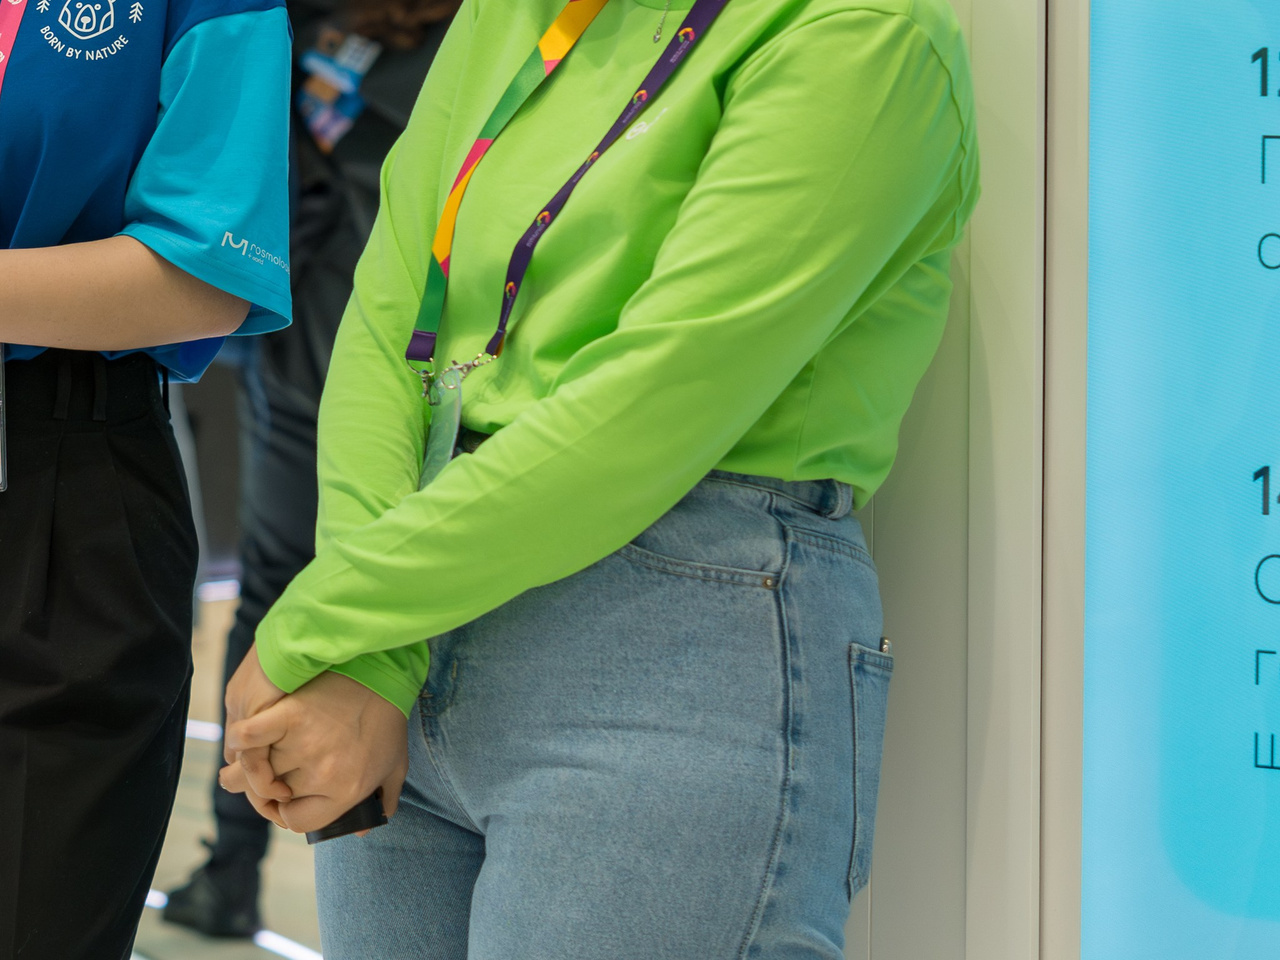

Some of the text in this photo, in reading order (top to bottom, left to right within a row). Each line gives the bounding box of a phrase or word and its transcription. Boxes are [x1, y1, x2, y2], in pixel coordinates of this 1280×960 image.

[40, 25, 129, 61] BORN BY NATURE
